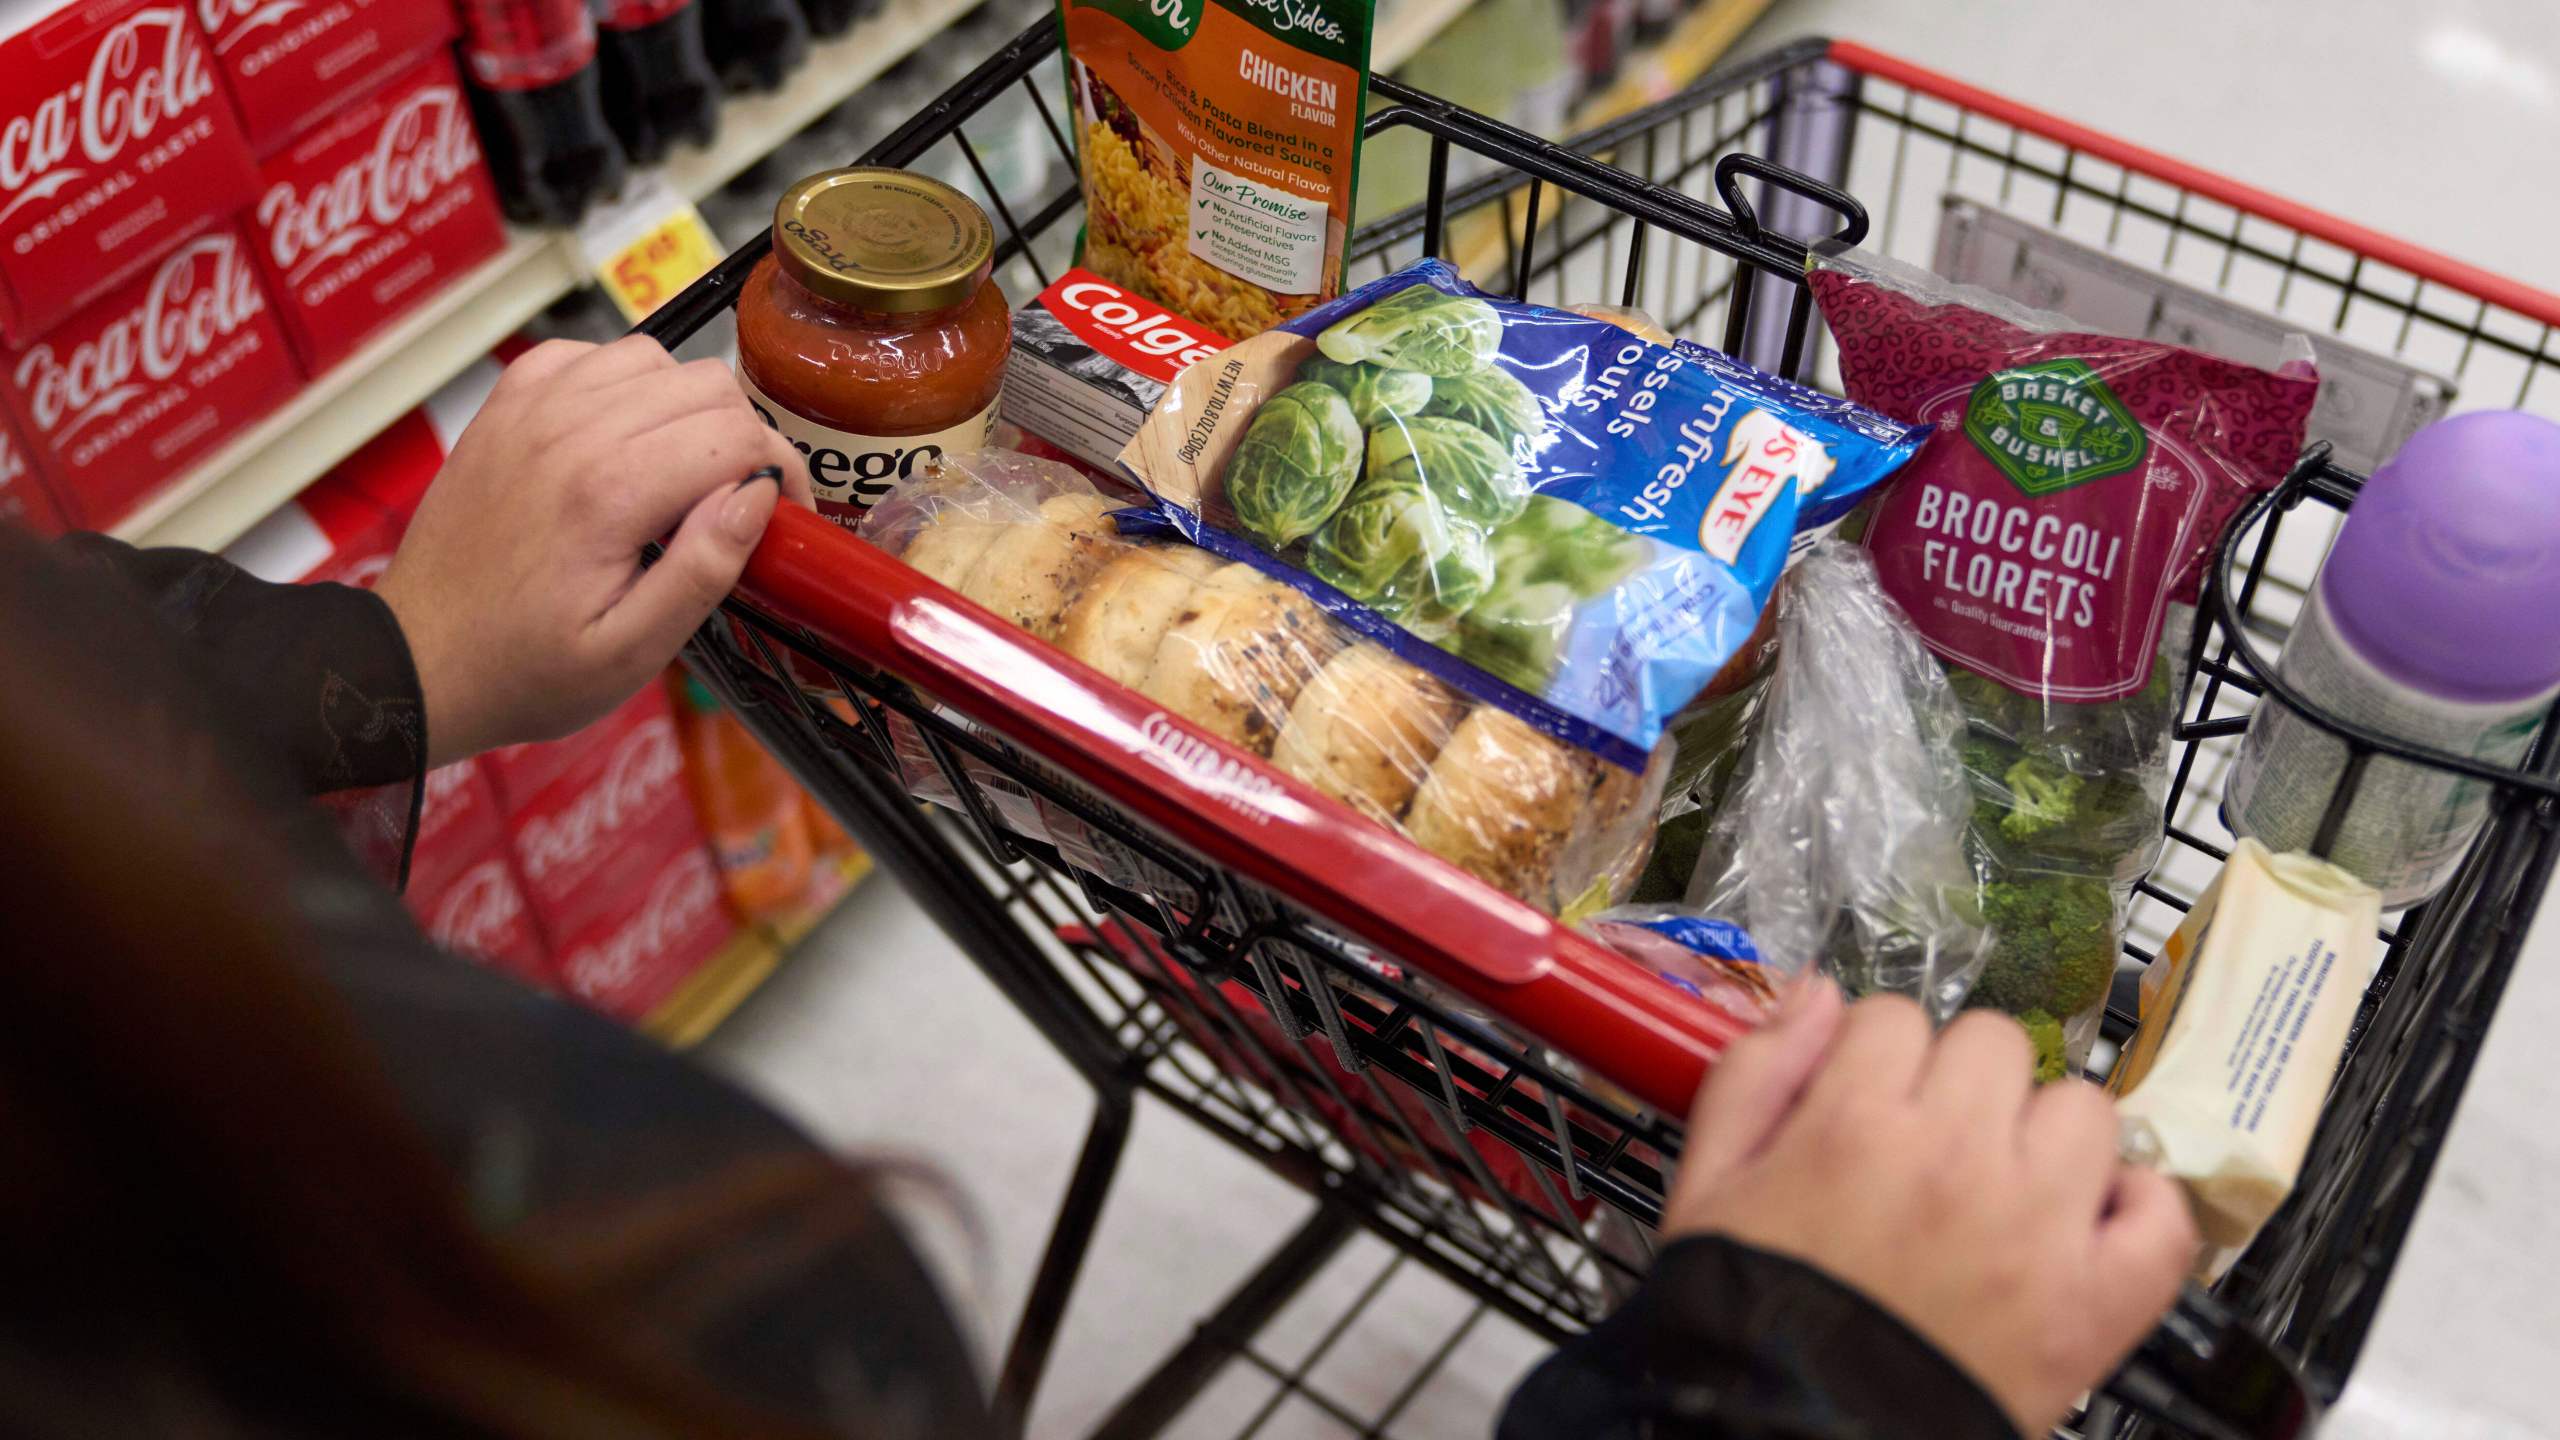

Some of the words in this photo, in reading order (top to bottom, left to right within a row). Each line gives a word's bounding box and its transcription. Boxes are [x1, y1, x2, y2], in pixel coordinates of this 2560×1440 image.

[0, 6, 214, 191] ca-Cola
[1239, 48, 1337, 110] CHICKEN
[1166, 68, 1188, 96] Rice
[1189, 89, 1199, 107] &
[1202, 97, 1243, 131] Pasta
[1247, 121, 1297, 147] Blend
[1302, 135, 1318, 152] in
[1323, 146, 1334, 158] a
[1291, 103, 1336, 127] FLAVOR
[1177, 120, 1197, 145] With
[1198, 137, 1230, 163] Other
[1233, 156, 1285, 181] Natural
[1288, 172, 1332, 195] Flavor
[1205, 119, 1275, 157] Flavored
[1279, 146, 1333, 175] Sauce
[13, 170, 137, 255] ORIGINAL
[138, 116, 215, 174] TASTE
[257, 86, 481, 268] Coca-Cola
[1202, 171, 1233, 194] Our
[1235, 185, 1310, 221] Promise
[784, 220, 863, 272] Prego
[1211, 229, 1226, 243] No
[1227, 238, 1262, 259] Added
[1263, 251, 1291, 267] MSG
[1212, 202, 1227, 216] No
[1228, 210, 1274, 233] Artificial
[1275, 226, 1318, 243] Flavors
[1212, 214, 1223, 226] or
[1224, 219, 1295, 251] Preservatives
[14, 233, 266, 432] Coca-Cola
[1060, 282, 1221, 365] Colga
[1214, 378, 1235, 400] WT
[1222, 359, 1245, 384] NET
[1606, 350, 1684, 438] ssels
[1196, 416, 1216, 435] OZ
[1204, 397, 1226, 420] 10.8
[2002, 382, 2109, 424] BASKET
[2038, 417, 2059, 437] &
[1176, 428, 1209, 466] (306g)
[1620, 383, 1736, 521] mfresh
[1989, 427, 2093, 467] BUSHEL
[1714, 464, 1776, 533] EYE
[1915, 484, 2121, 580] BROCCOLI
[1923, 540, 2095, 628] FLORETS
[1951, 599, 1989, 624] Quality
